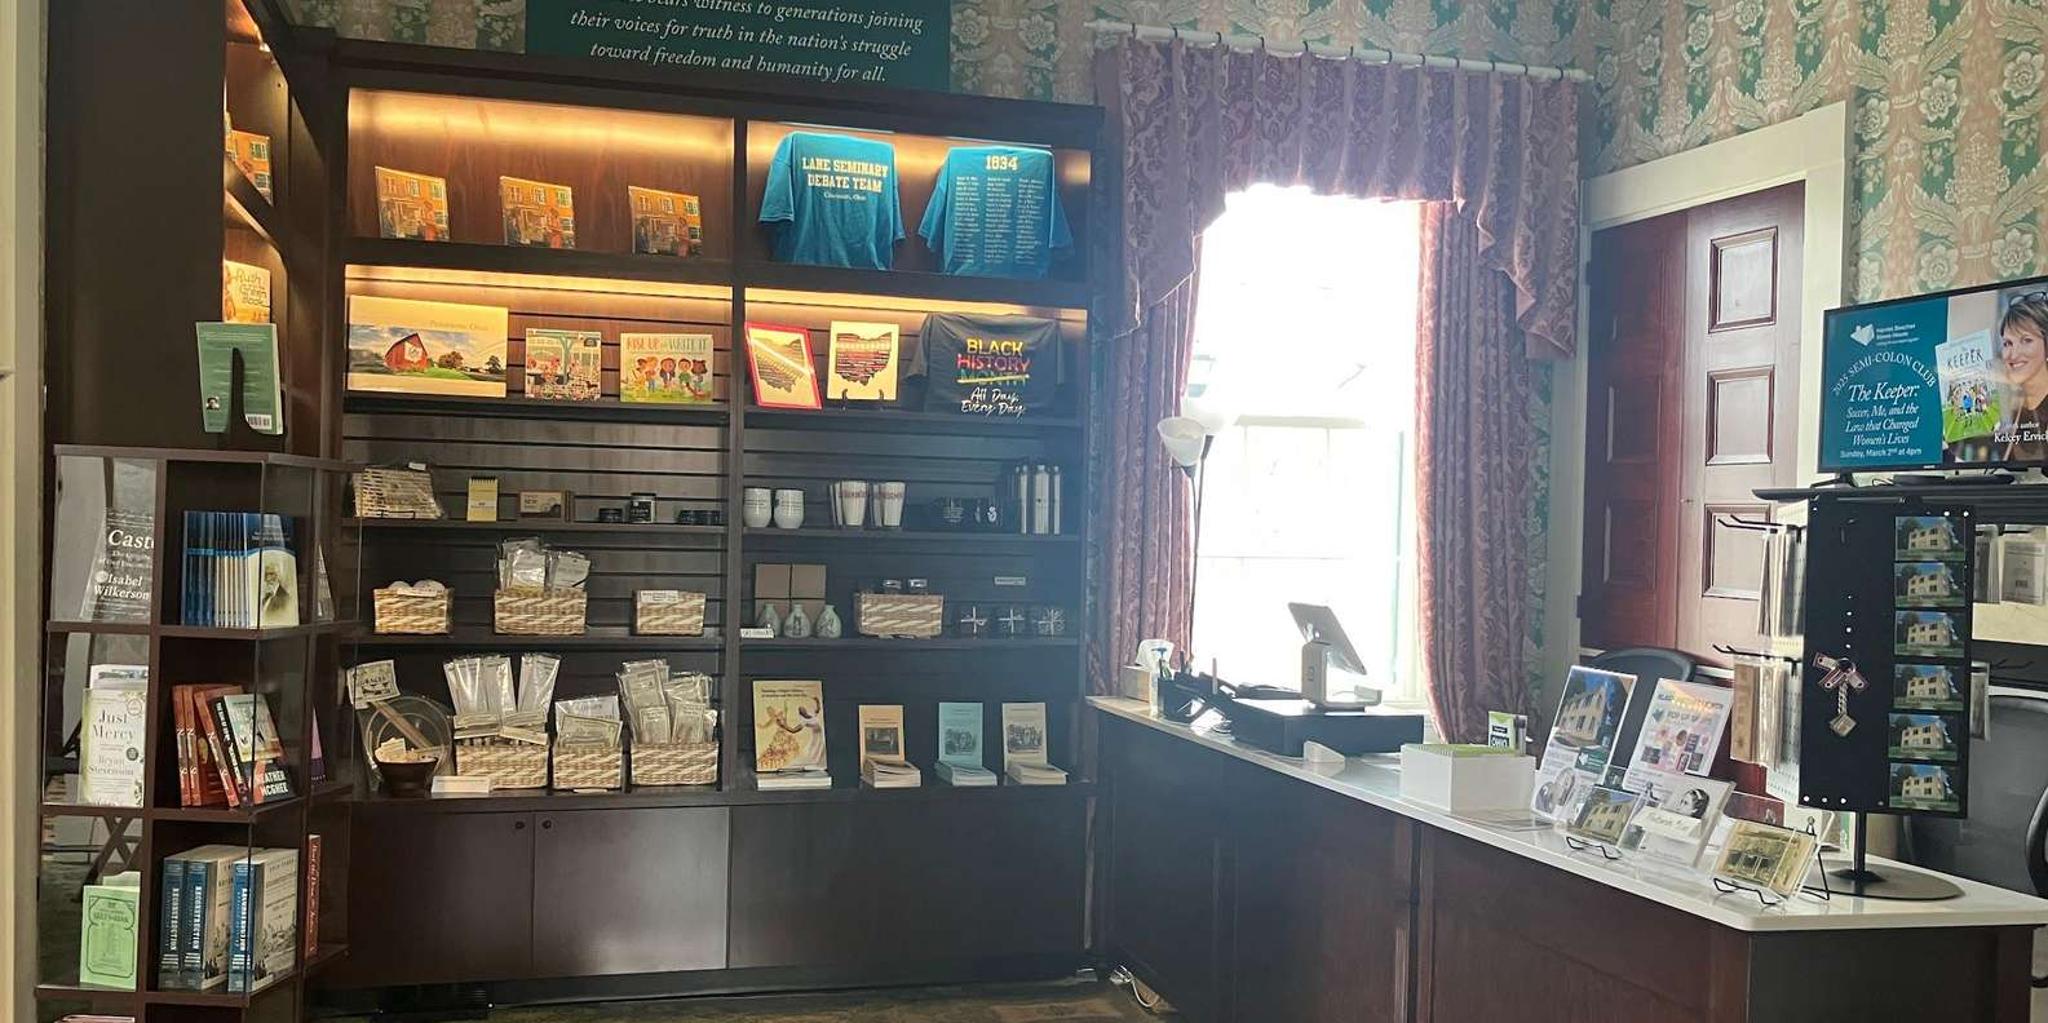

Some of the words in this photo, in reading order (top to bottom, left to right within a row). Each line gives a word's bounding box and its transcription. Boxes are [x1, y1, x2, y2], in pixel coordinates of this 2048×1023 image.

[695, 0, 753, 13] witness
[757, 2, 772, 15] to
[775, 7, 864, 24] generations
[864, 10, 924, 35] joining
[570, 10, 610, 28] their
[614, 16, 660, 33] voices
[660, 19, 688, 39] for
[692, 24, 733, 40] truth
[738, 26, 757, 42] in
[759, 28, 783, 44] the
[787, 34, 848, 50] nation's
[851, 41, 912, 60] struggle
[590, 43, 650, 61] toward
[652, 47, 717, 67] freedom
[721, 55, 753, 70] and
[757, 56, 833, 82] humanity
[832, 63, 859, 83] for
[862, 66, 886, 82] all.
[802, 157, 832, 171] LANE
[833, 160, 889, 178] SEMINARY
[986, 155, 1018, 171] 1834
[807, 173, 850, 189] DEBATE
[852, 177, 882, 193] TEAM
[966, 338, 1024, 356] BLACK
[957, 353, 1031, 372] HISTORY
[1947, 349, 1983, 370] KEEPER
[1849, 351, 1913, 377] SEMI-COLON
[1912, 360, 1936, 388] CLUB
[970, 386, 988, 404] All
[1848, 384, 1871, 402] The
[1873, 382, 1920, 404] Keeper:
[961, 400, 996, 416] Every
[1888, 403, 1906, 415] and
[1905, 402, 1920, 414] the
[1882, 416, 1920, 434] Changed
[1853, 433, 1886, 446] Women's
[1887, 432, 1910, 445] Lives
[108, 573, 143, 587] Isabel
[94, 584, 151, 600] Wilkerson
[98, 709, 128, 724] Just
[93, 724, 135, 741] Mercy
[192, 886, 202, 950] RECONSTRUCTION
